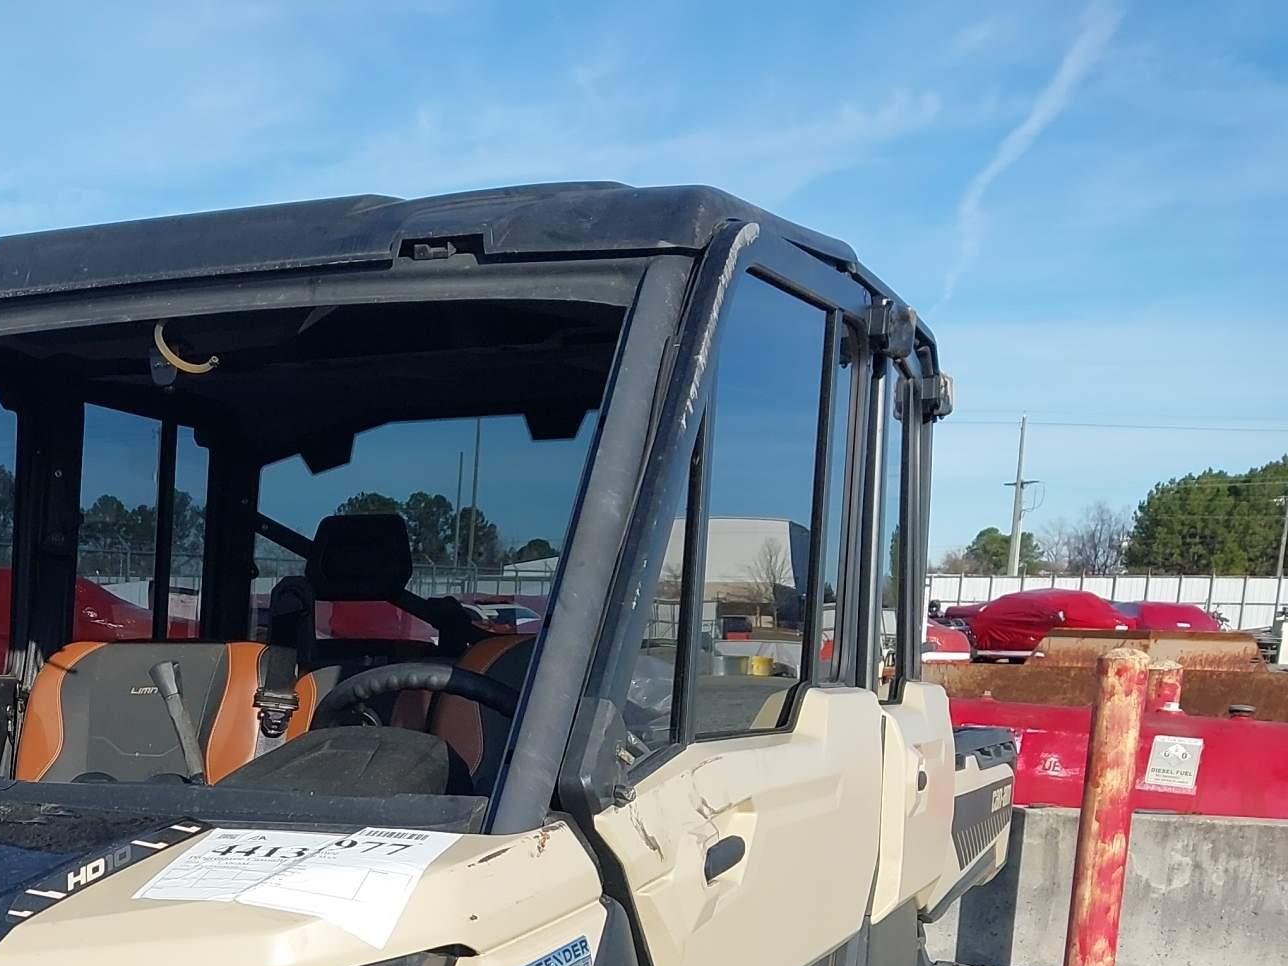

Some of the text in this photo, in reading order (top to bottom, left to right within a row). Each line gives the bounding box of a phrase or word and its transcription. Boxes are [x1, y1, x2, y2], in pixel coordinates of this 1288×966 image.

[1150, 767, 1174, 775] DIESEL
[1175, 769, 1193, 777] FUEL
[67, 844, 132, 892] HD10
